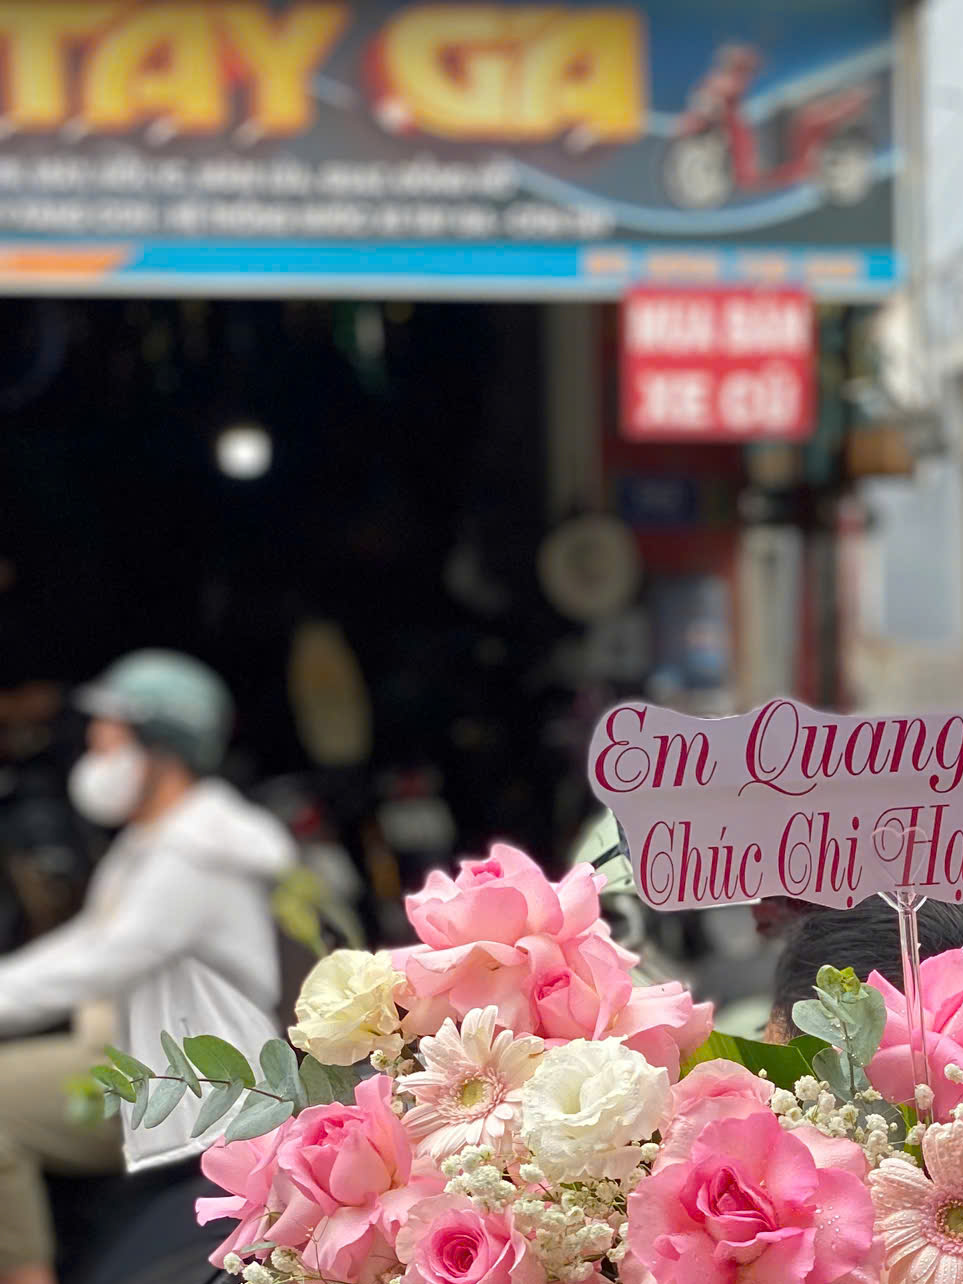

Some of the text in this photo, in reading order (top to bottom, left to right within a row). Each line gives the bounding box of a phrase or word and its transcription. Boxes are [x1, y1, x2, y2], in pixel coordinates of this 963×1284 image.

[382, 8, 645, 143] GA
[594, 706, 718, 793] Em
[640, 820, 763, 906] Chúc
[777, 811, 863, 909] Chị
